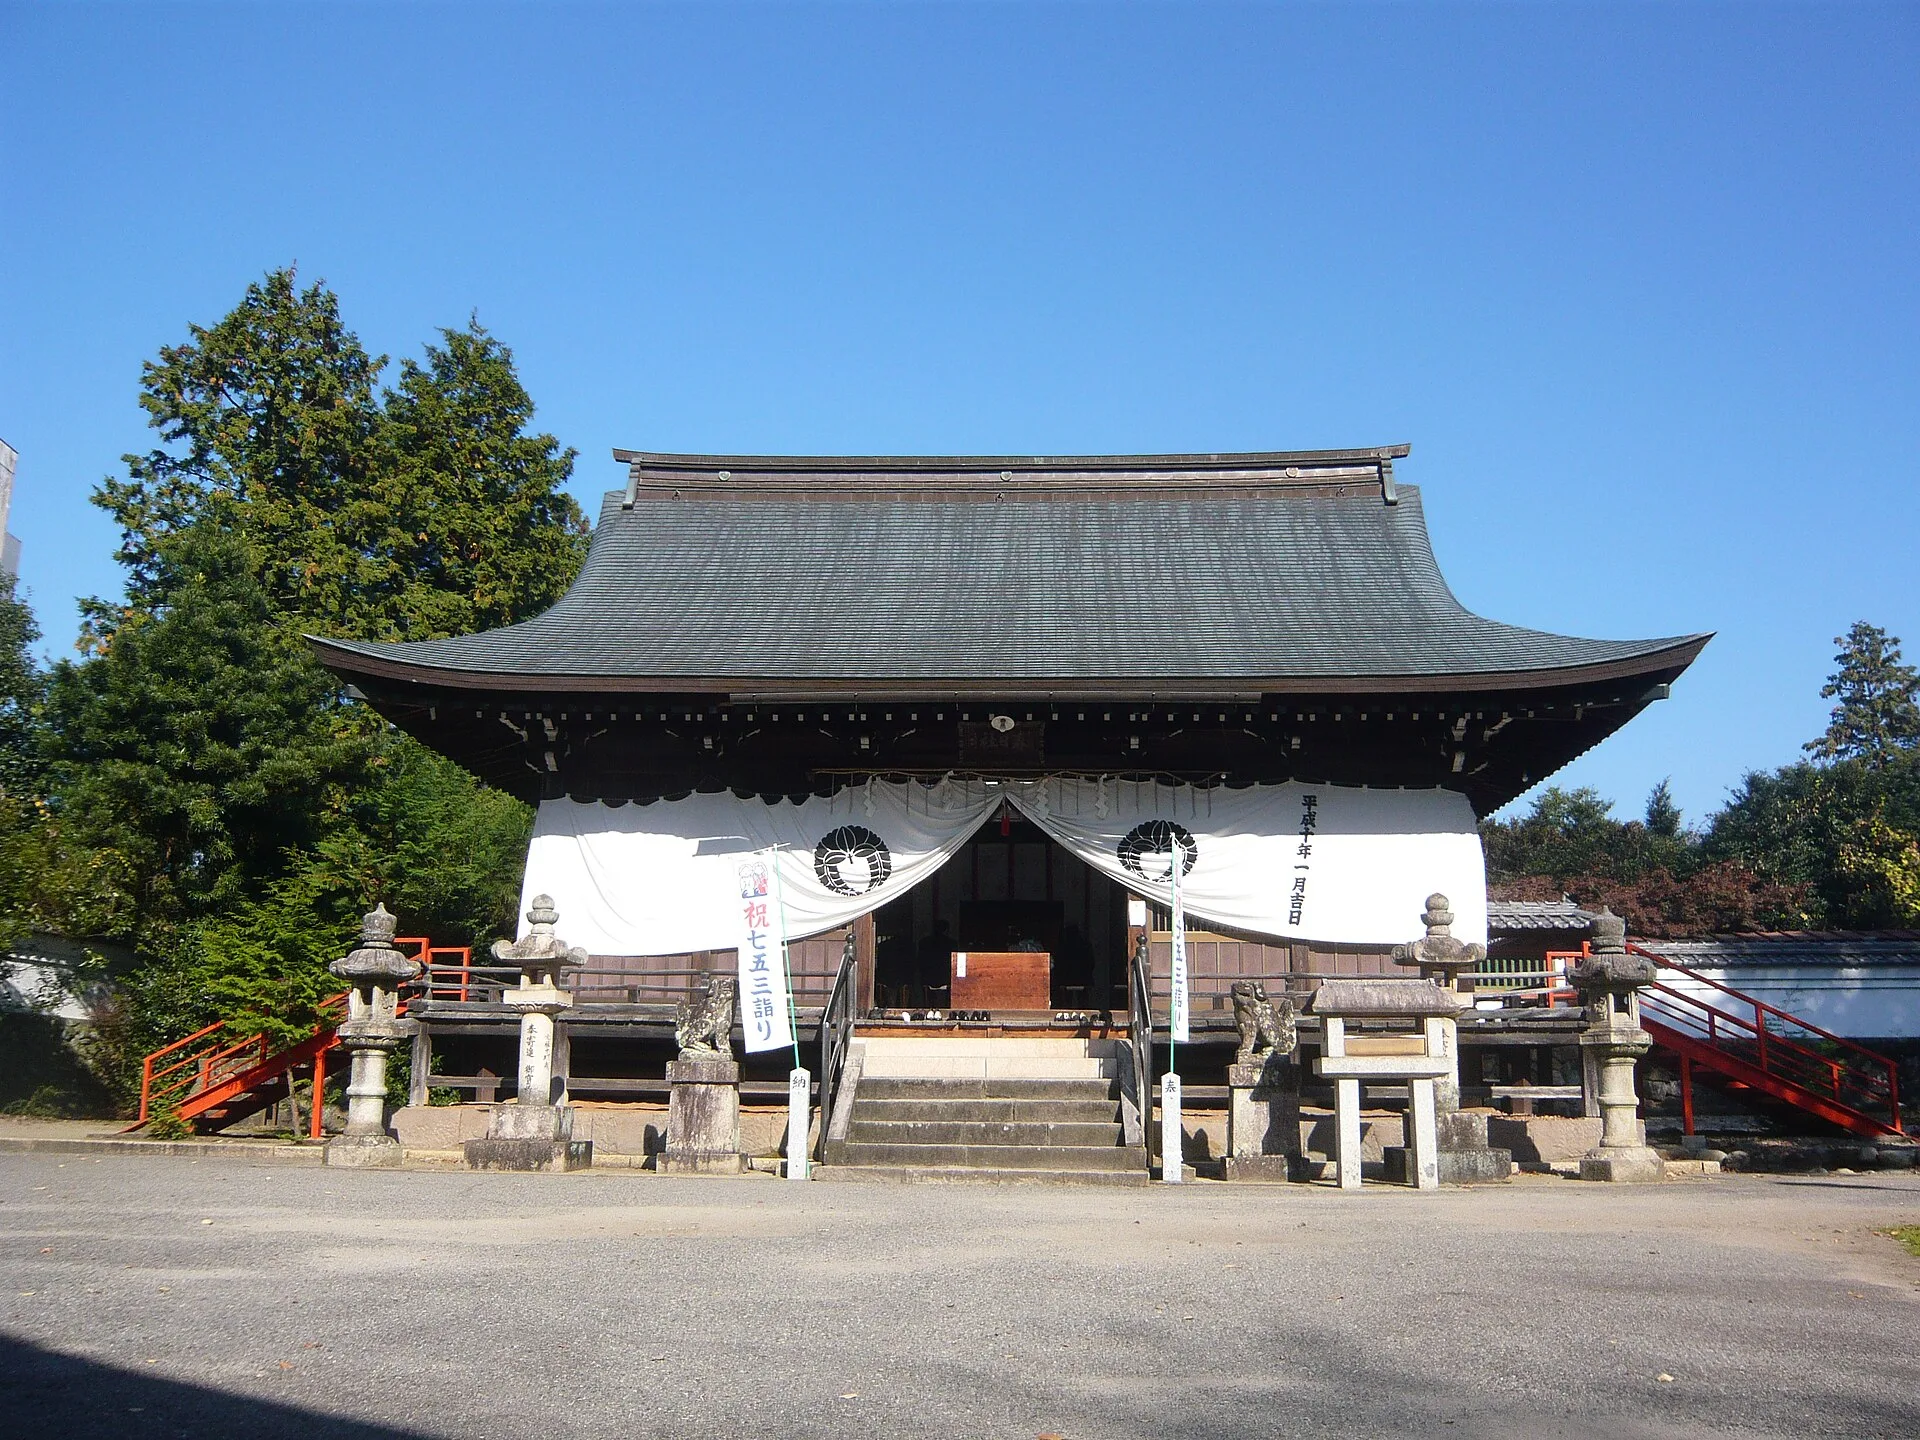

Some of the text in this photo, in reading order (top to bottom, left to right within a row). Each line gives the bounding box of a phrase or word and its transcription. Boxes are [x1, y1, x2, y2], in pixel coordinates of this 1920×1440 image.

[1288, 794, 1318, 926] 平成十年一月吉日
[743, 901, 774, 1041] 祝七五三詣り
[792, 1075, 806, 1089] 納
